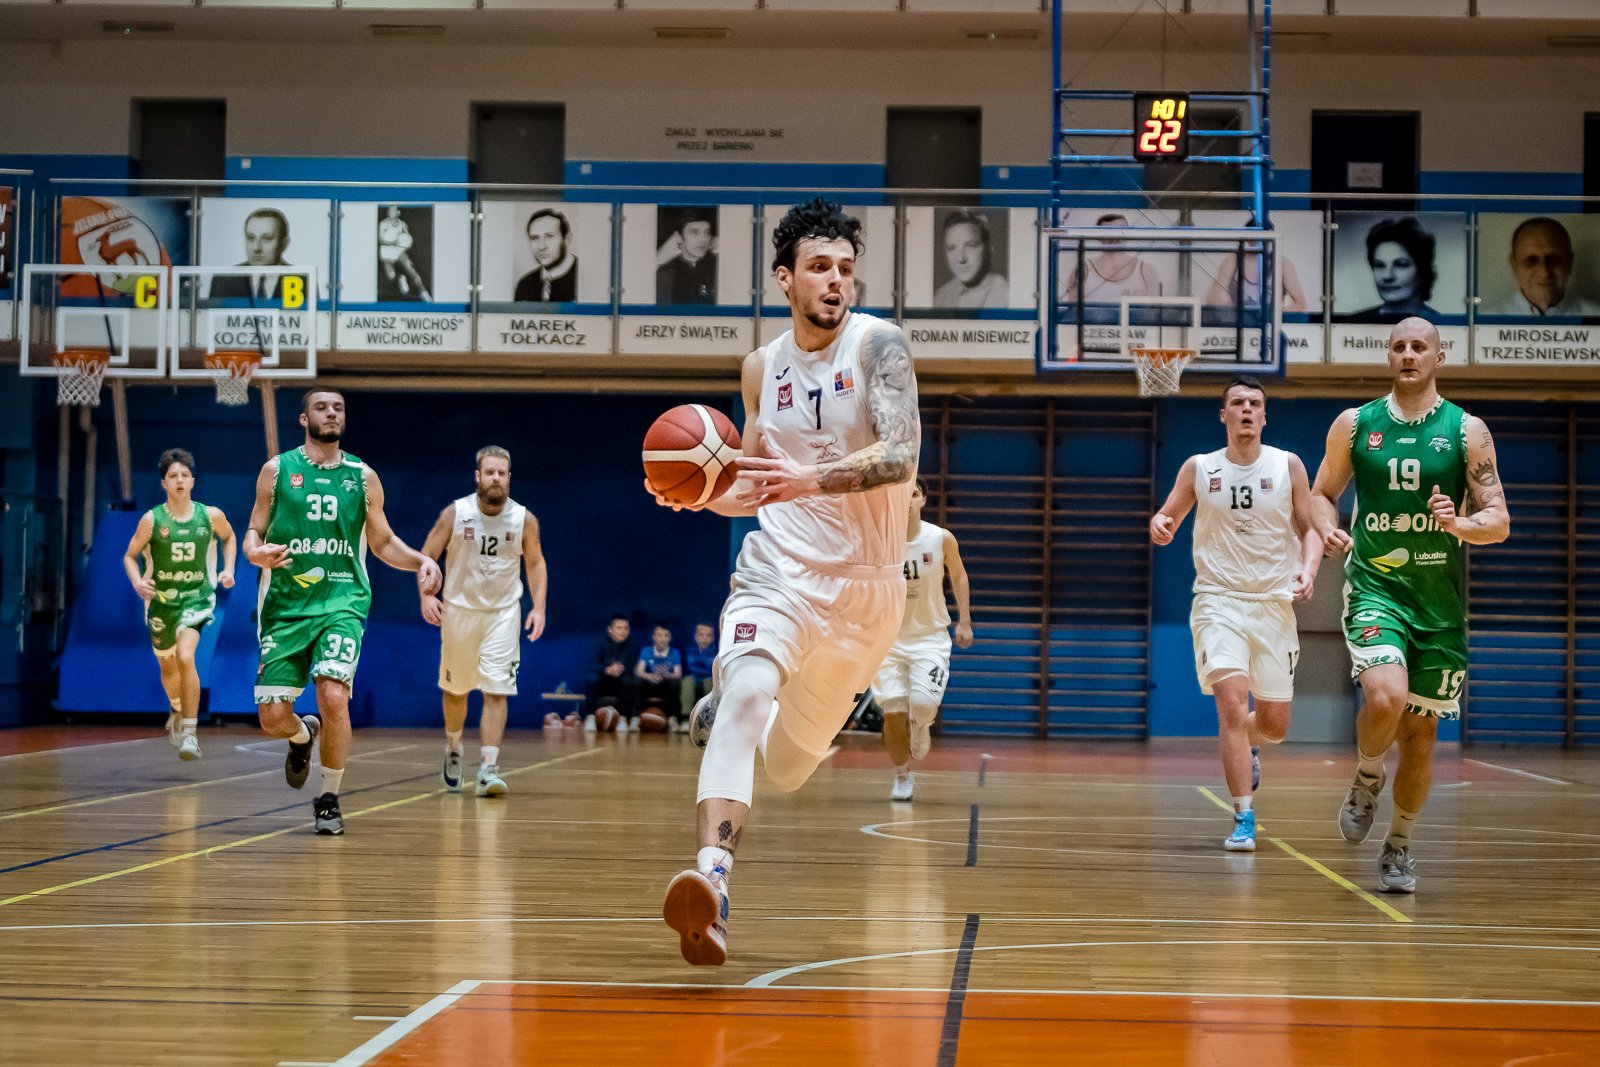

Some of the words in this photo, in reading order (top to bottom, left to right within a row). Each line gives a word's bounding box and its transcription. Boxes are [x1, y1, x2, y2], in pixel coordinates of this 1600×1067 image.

[1140, 120, 1181, 152] 22
[135, 275, 157, 308] C
[281, 275, 304, 308] B
[226, 315, 301, 328] MARIAN
[346, 316, 397, 330] JANUSZ
[511, 319, 576, 331] MAREK
[636, 325, 676, 338] JERZY
[680, 323, 739, 341] ŚWIĄTEK
[366, 332, 443, 346] WICHOWSKI
[500, 332, 587, 346] TOŁKACZ
[911, 329, 958, 343] ROMAN
[963, 330, 1030, 344] MISIEWICZ
[1499, 329, 1590, 342] MIROSŁAW
[808, 387, 823, 430] 7
[1387, 458, 1421, 491] 19
[306, 494, 338, 521] 33
[1230, 486, 1253, 510] 13
[1365, 512, 1391, 532] Q8
[171, 541, 196, 562] 53
[289, 538, 311, 554] Q8
[480, 535, 499, 556] 12
[902, 559, 920, 580] 41
[324, 633, 357, 663] 33
[928, 664, 945, 687] 41
[1437, 669, 1466, 699] 19
